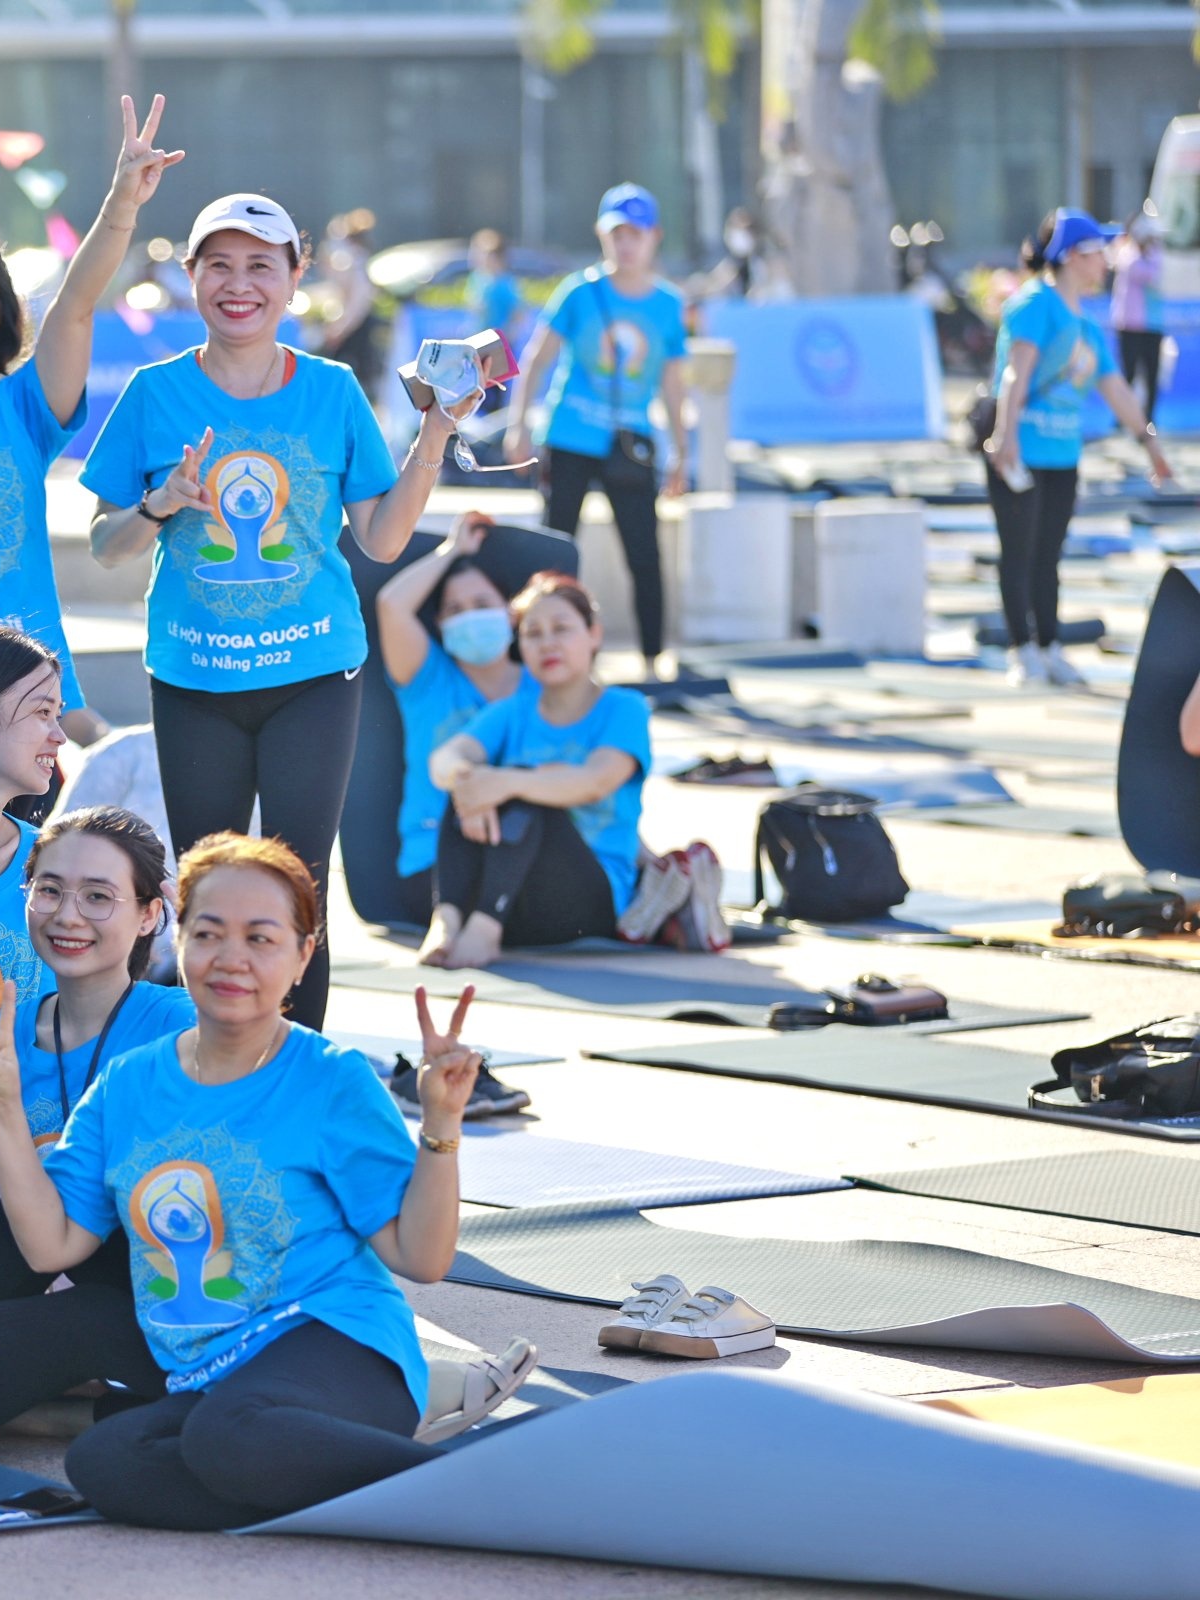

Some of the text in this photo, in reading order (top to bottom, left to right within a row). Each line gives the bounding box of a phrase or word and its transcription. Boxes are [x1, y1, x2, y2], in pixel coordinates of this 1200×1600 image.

[206, 633, 256, 649] YOGA
[259, 624, 310, 645] QUỐC
[312, 615, 332, 636] TẾ
[191, 651, 292, 672] Đà Nẵng 2022
